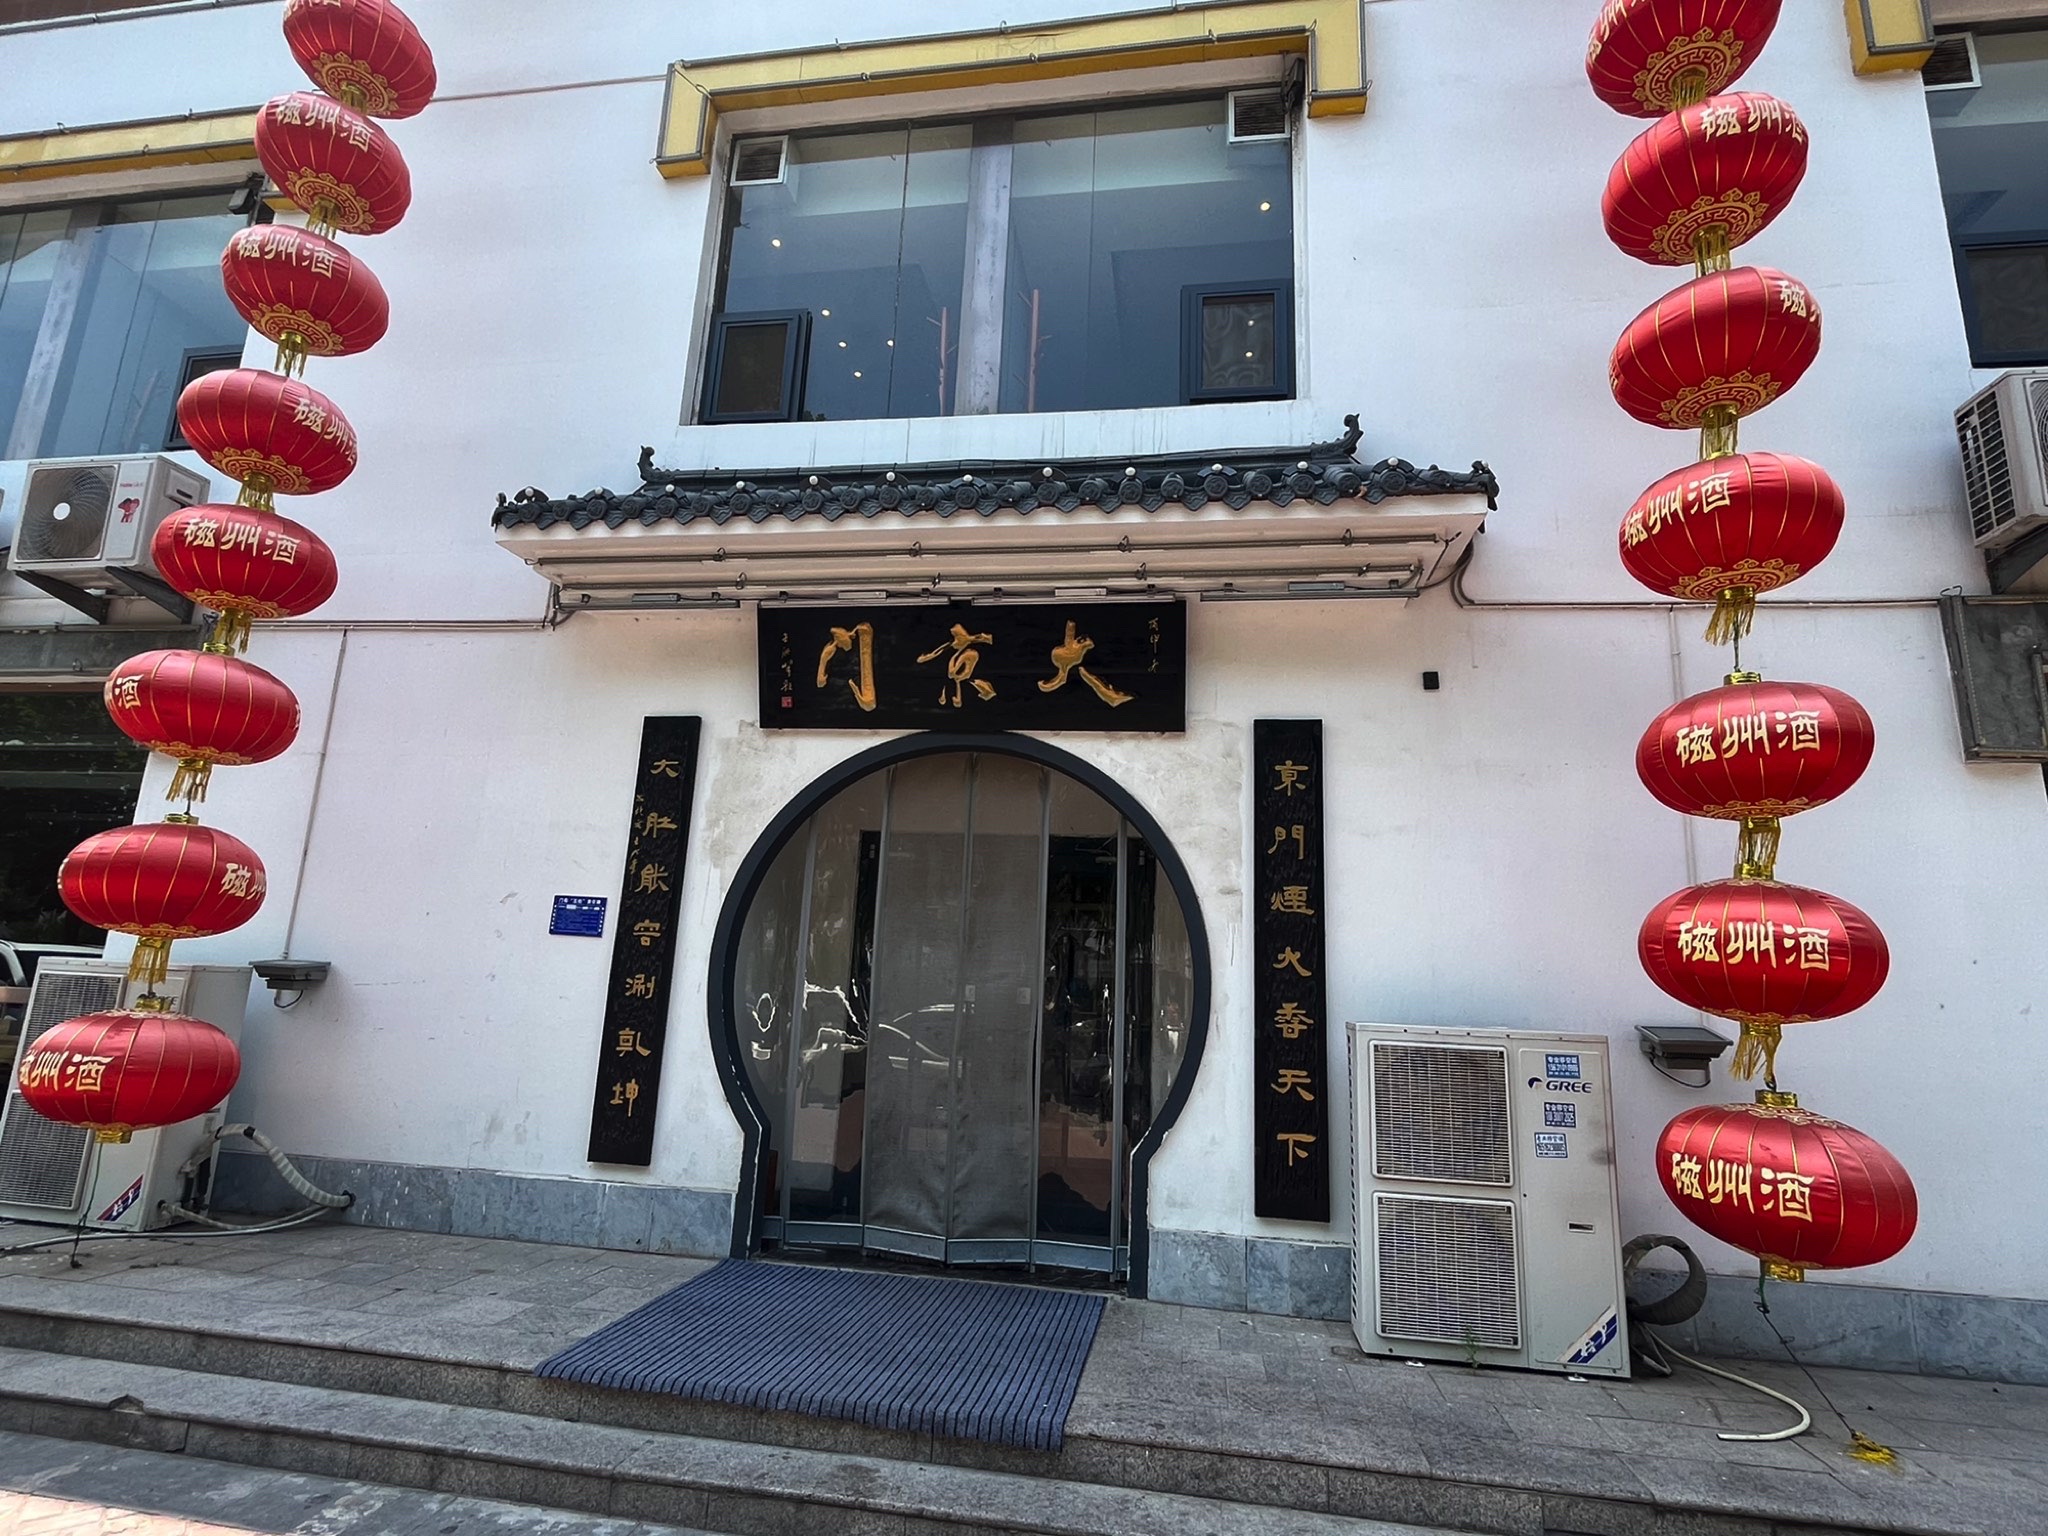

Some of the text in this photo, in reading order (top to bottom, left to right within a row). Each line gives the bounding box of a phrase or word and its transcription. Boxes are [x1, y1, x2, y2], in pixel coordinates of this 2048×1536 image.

[275, 96, 374, 153] 磁州酒
[235, 228, 335, 278] 磁州酒
[1625, 471, 1733, 548] 磁州酒
[182, 517, 298, 566] 磁州酒
[1676, 709, 1821, 768] 磁州酒
[1677, 919, 1831, 972] 磁州酒
[1546, 1080, 1593, 1093] GREE
[1671, 1151, 1815, 1223] 磁州酒
